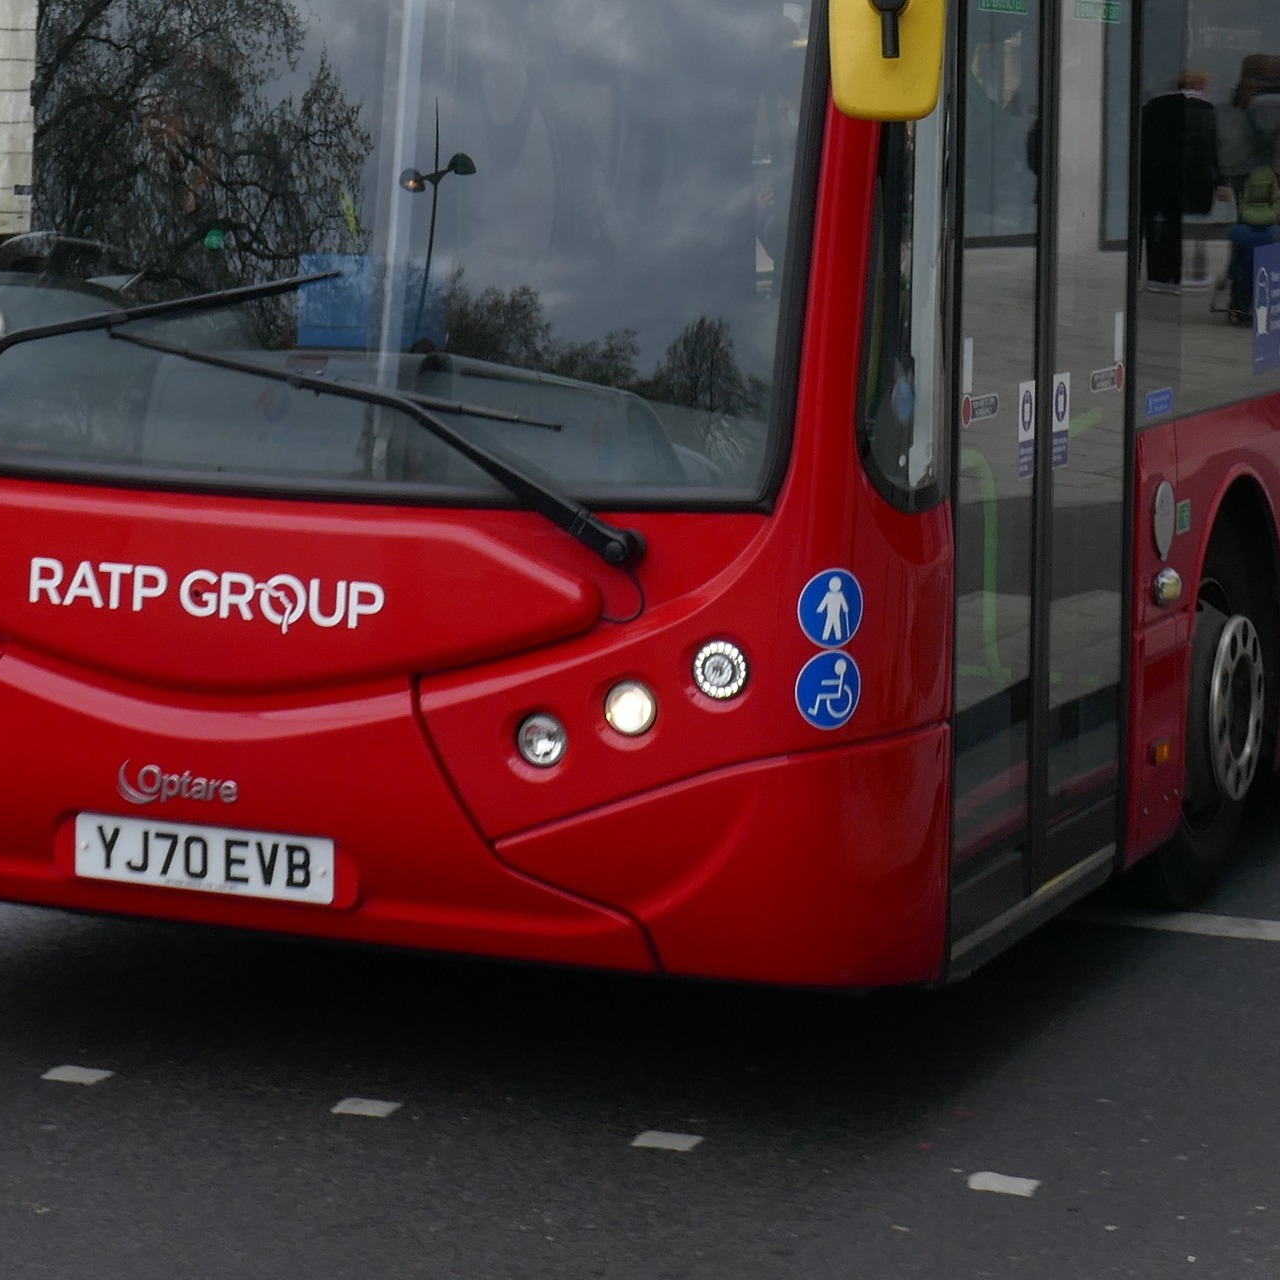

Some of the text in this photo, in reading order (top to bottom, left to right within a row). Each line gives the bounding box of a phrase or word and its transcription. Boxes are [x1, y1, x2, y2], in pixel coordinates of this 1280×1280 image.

[28, 556, 386, 633] RATP GROUP
[136, 763, 239, 804] Optare
[96, 825, 312, 889] YJ70 EVB
